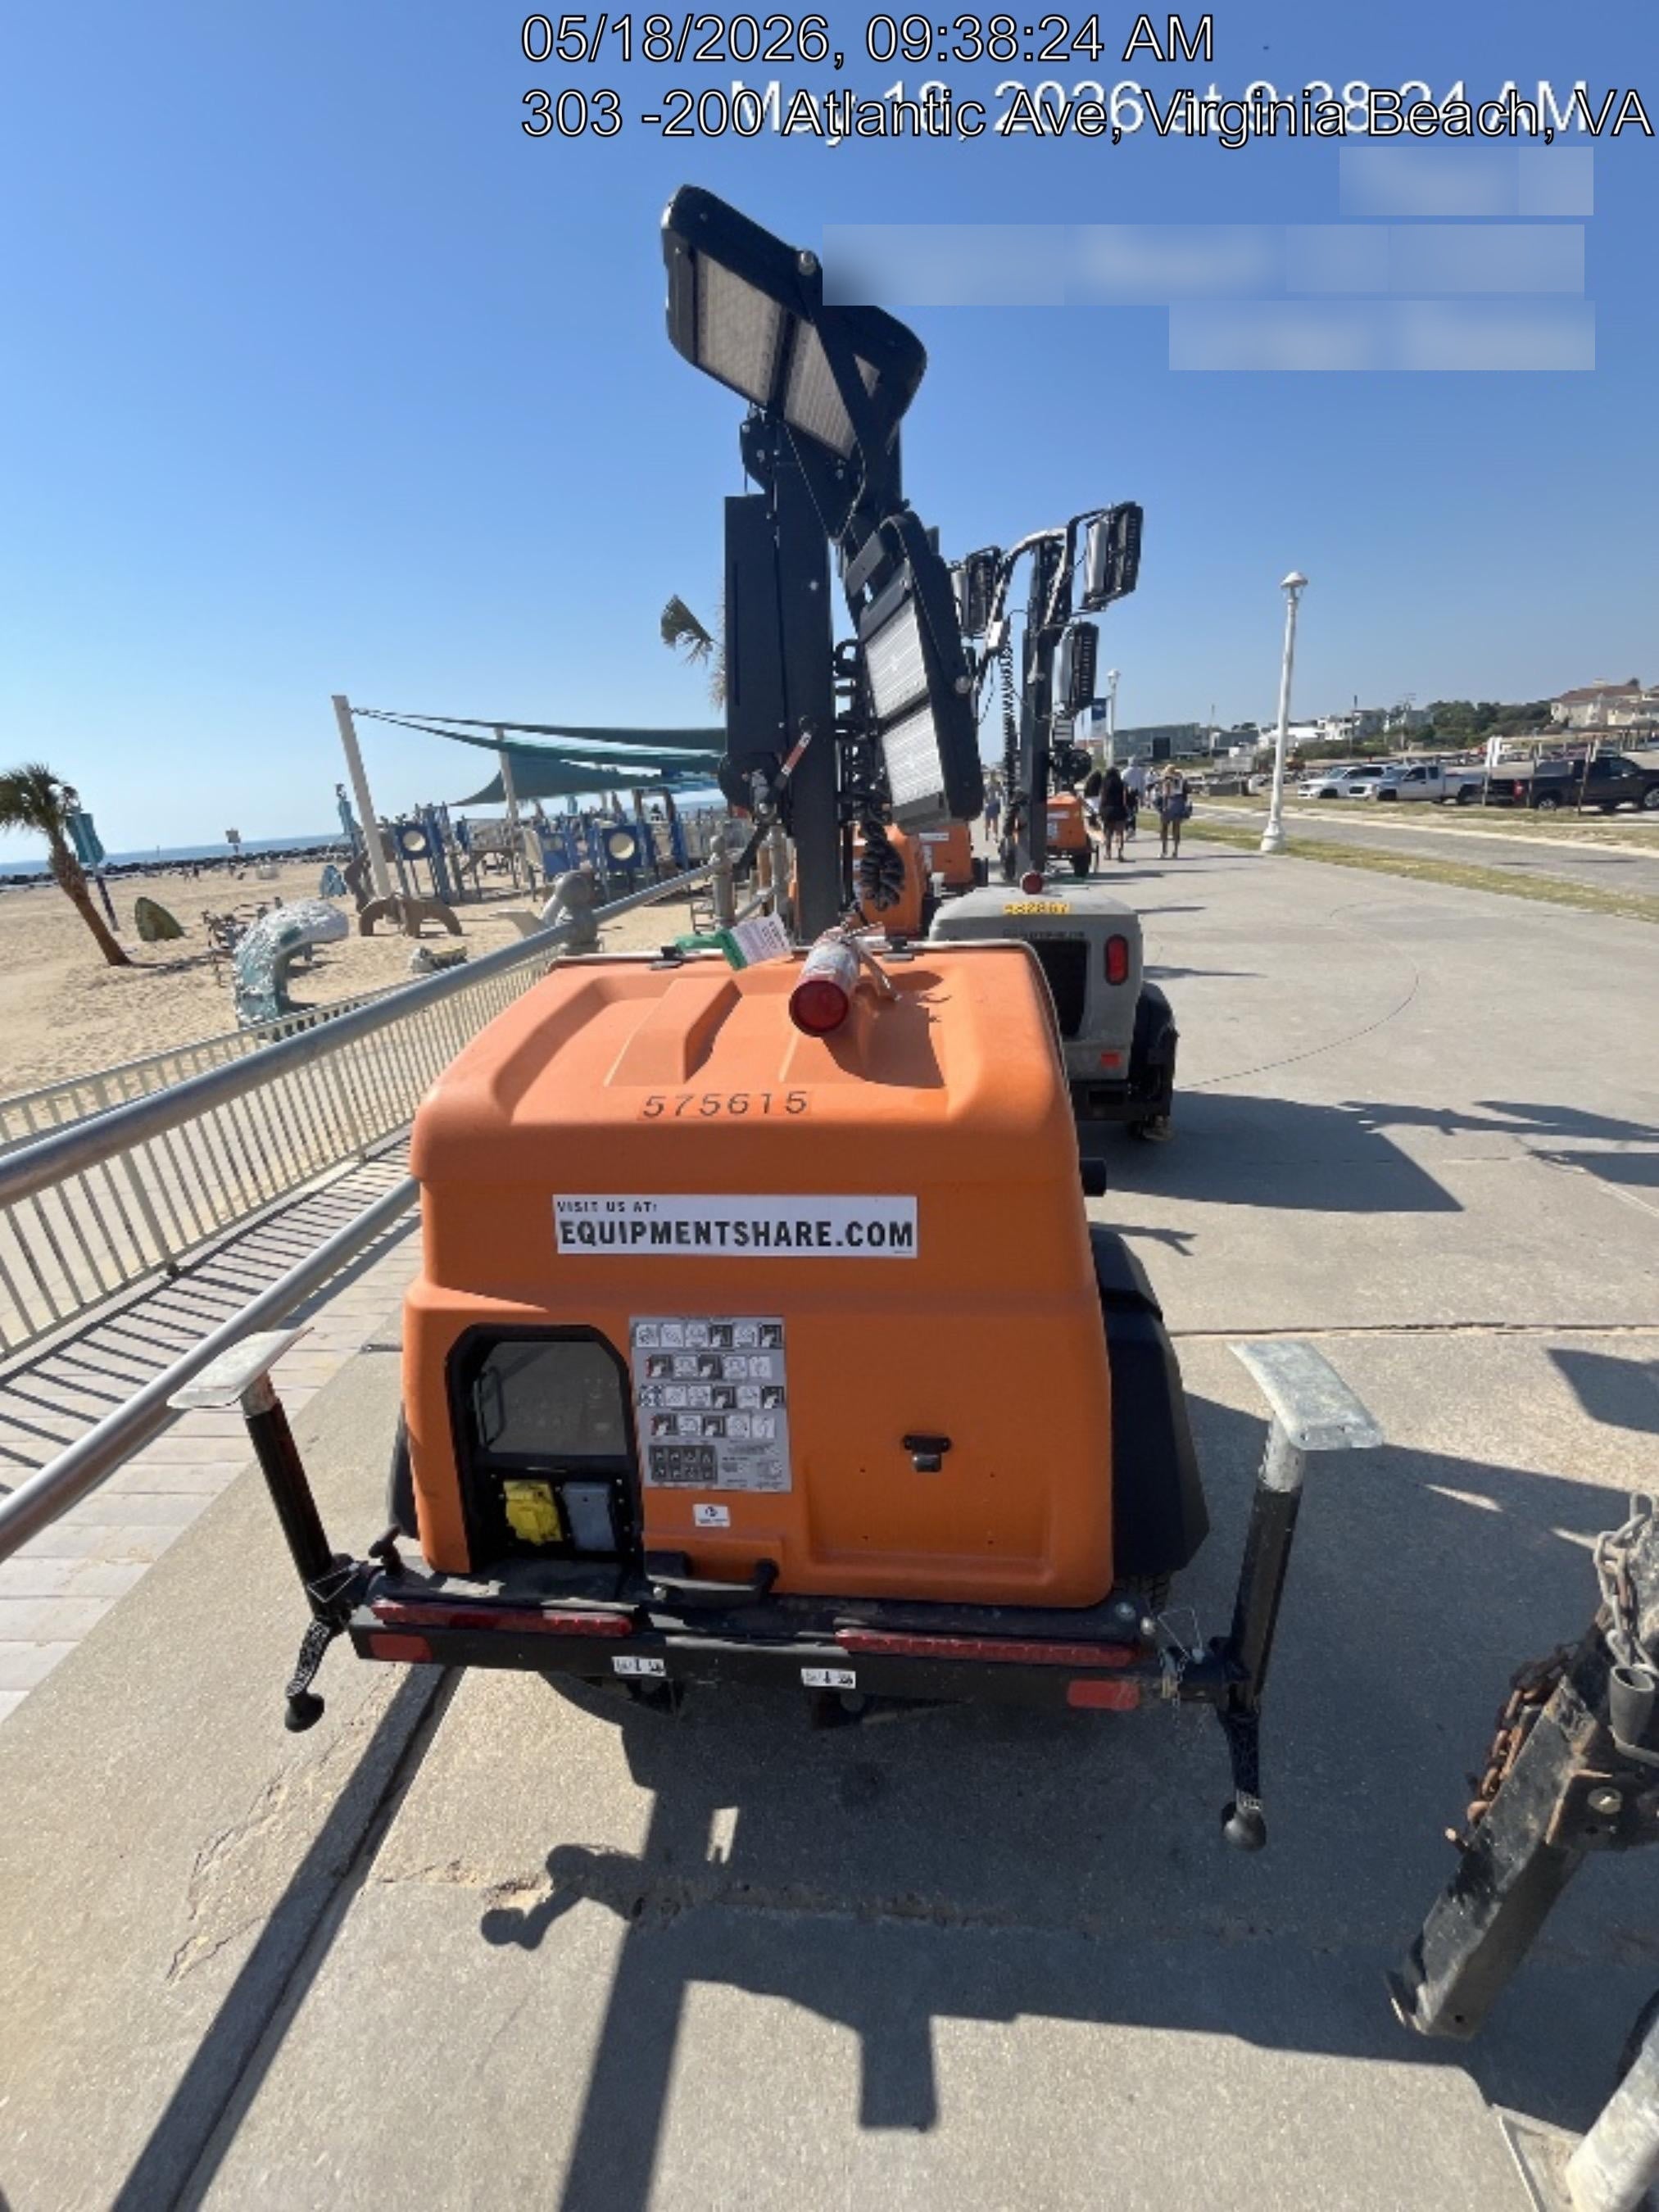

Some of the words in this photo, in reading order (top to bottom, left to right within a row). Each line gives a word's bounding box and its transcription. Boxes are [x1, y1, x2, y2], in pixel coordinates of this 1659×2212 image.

[643, 1090, 807, 1117] 575615
[557, 1201, 598, 1213] VISIT
[606, 1201, 625, 1213] US
[633, 1201, 657, 1213] AT:
[560, 1220, 913, 1248] EQUIPMENTSHARE.COM
